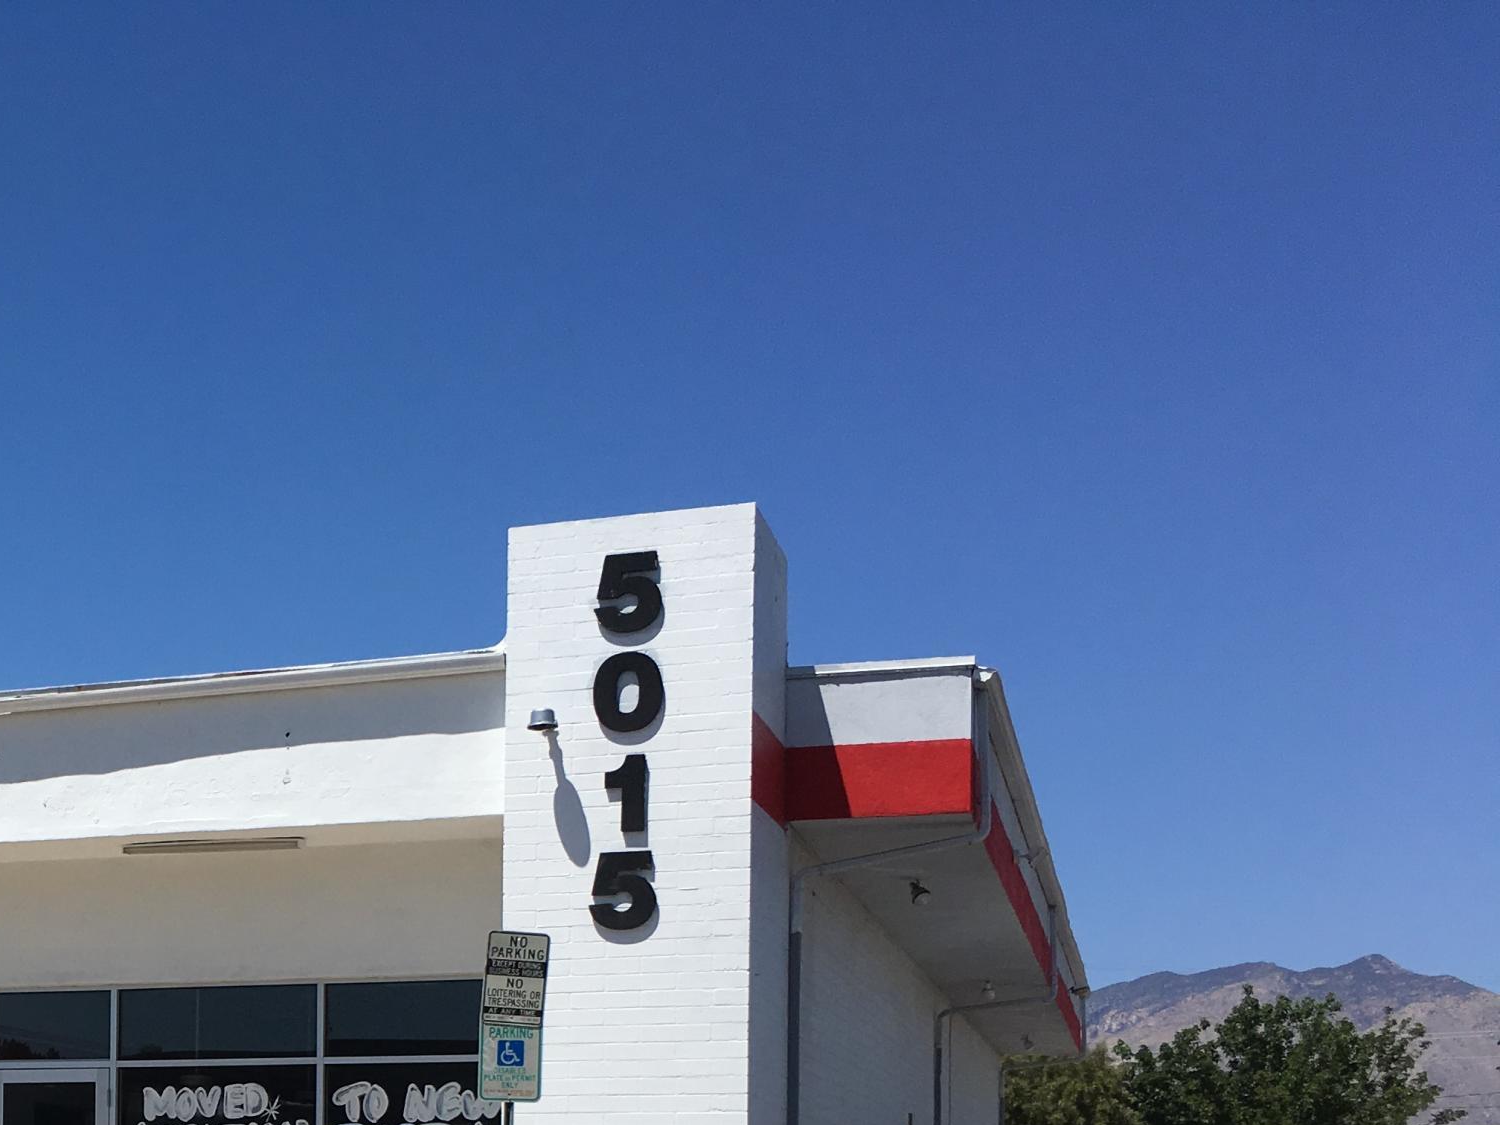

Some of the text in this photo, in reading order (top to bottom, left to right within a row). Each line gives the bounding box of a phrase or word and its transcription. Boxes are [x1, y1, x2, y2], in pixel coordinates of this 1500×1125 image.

[589, 550, 664, 931] 5015
[510, 936, 528, 948] NO
[491, 947, 545, 961] PARKING
[492, 961, 517, 969] EXCEPT
[506, 978, 524, 989] NO
[487, 988, 541, 1000] LOITERING OR
[487, 997, 540, 1009] TRESPASSING
[488, 1006, 498, 1014] AT
[500, 1008, 516, 1016] ANY
[489, 1027, 534, 1039] PARKING
[484, 1073, 502, 1081] PLATE
[512, 1074, 536, 1083] PERMIT
[500, 1081, 519, 1089] ONLY
[143, 1081, 501, 1123] MOVED TO NEW
